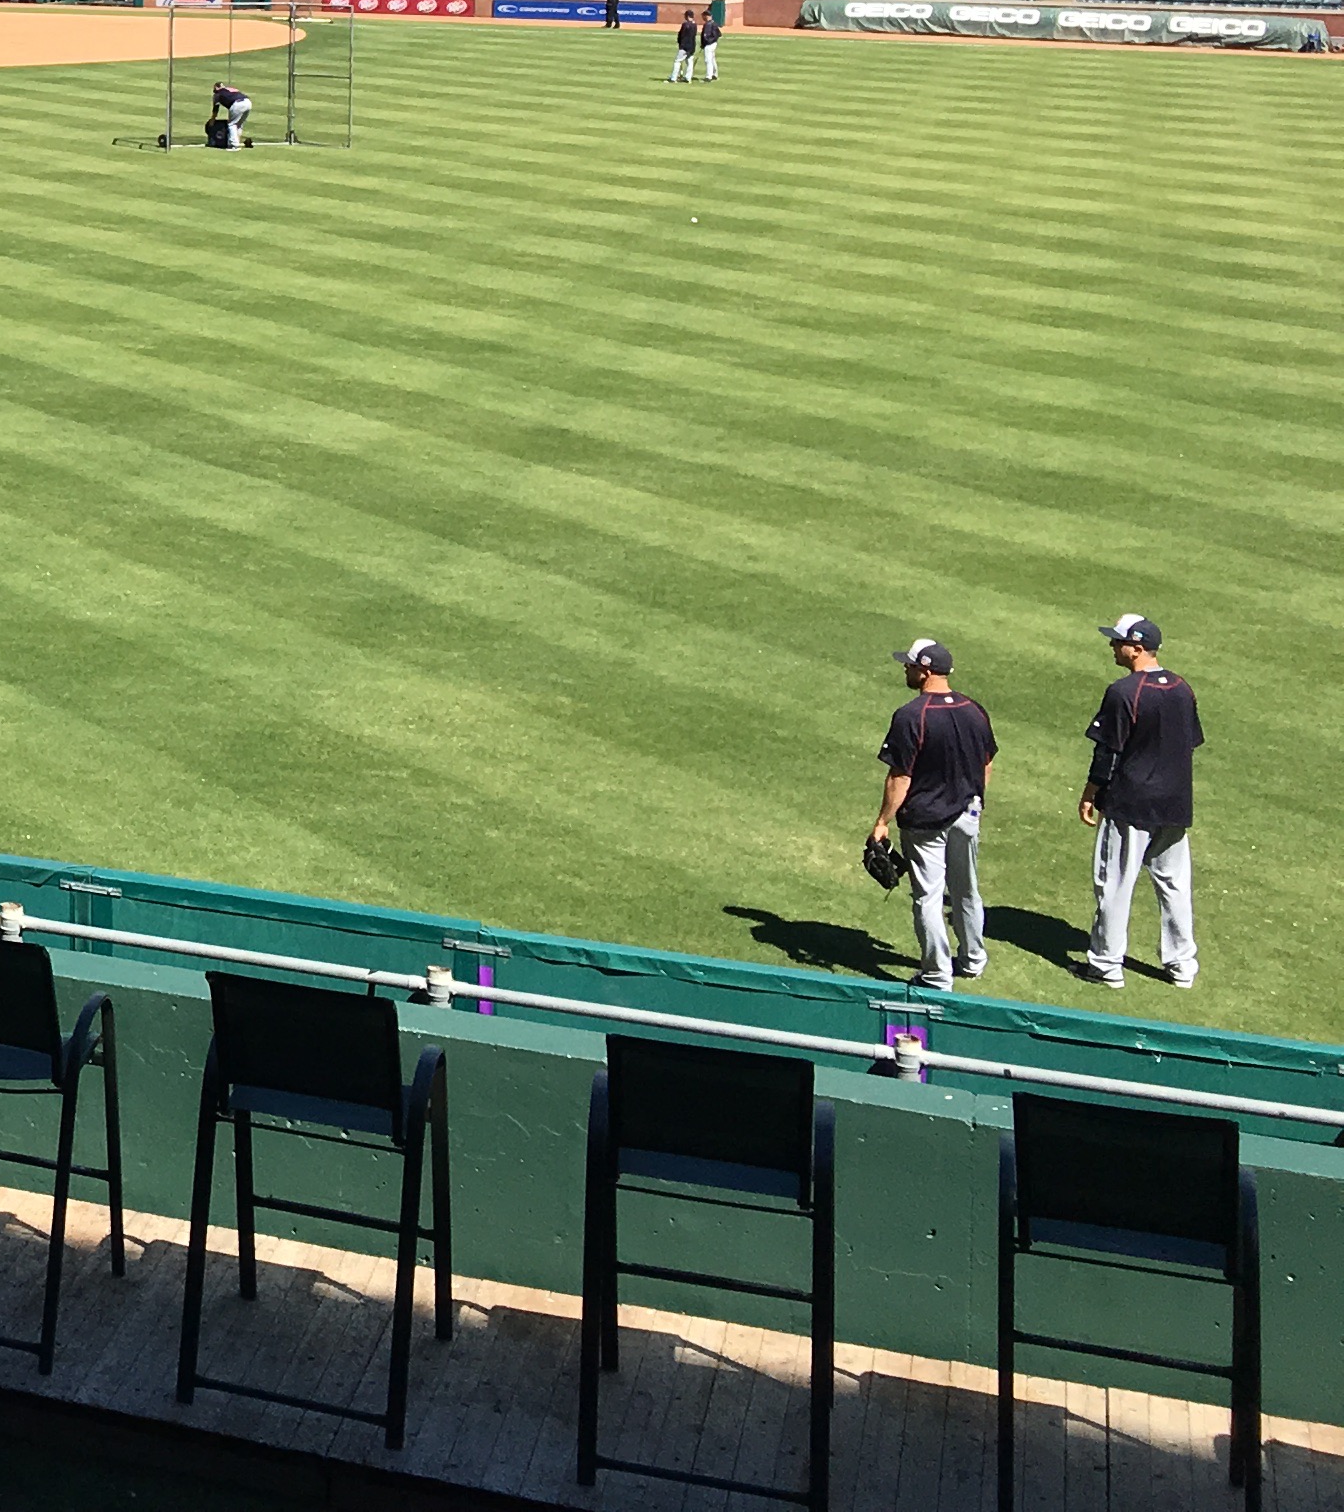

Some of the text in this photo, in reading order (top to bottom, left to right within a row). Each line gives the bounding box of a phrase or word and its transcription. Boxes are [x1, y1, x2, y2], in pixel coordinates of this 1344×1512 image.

[845, 2, 933, 18] GEICO
[949, 5, 1041, 25] GEICO
[1057, 10, 1152, 31] GEICO
[1167, 16, 1266, 36] GEICO
